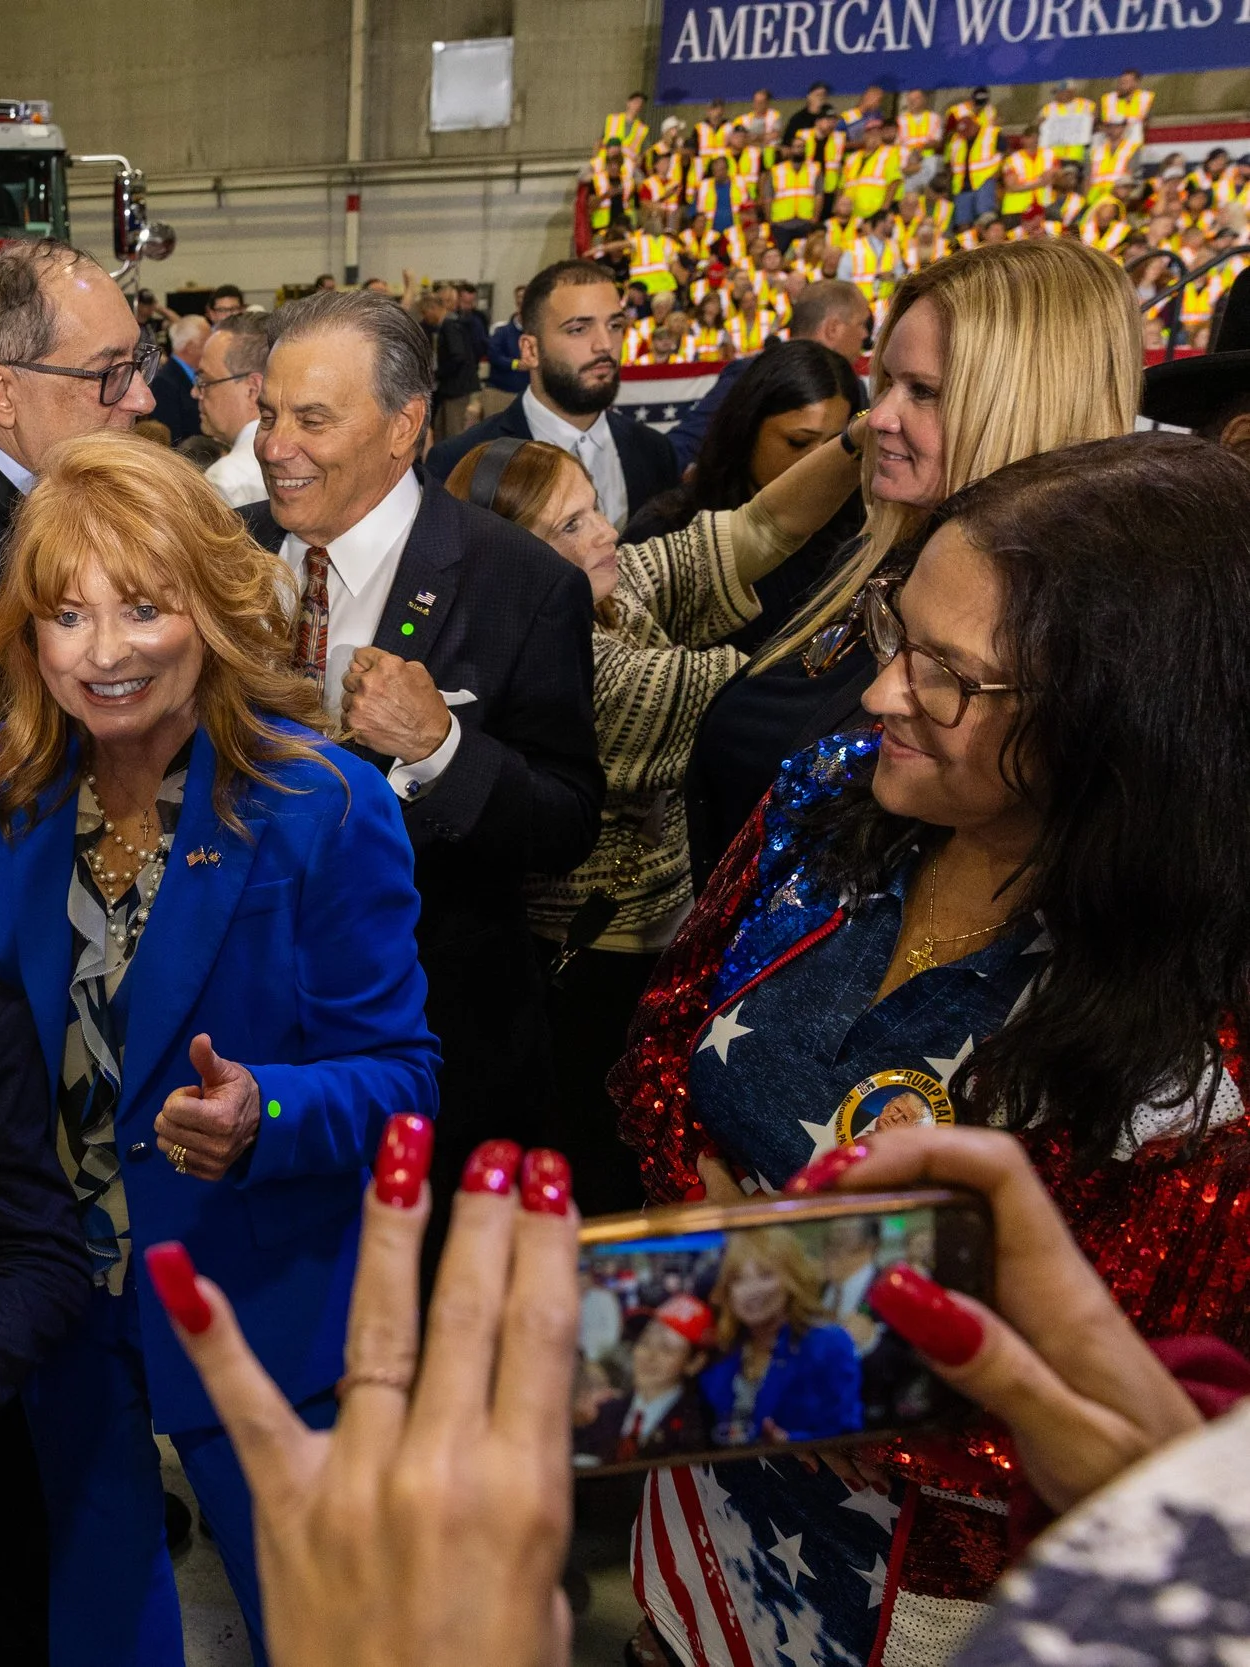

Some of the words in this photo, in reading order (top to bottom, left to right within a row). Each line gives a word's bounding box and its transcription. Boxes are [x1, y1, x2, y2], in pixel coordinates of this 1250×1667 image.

[670, 0, 939, 64] AMERICAN
[894, 1070, 941, 1099] TRUMP
[836, 1094, 854, 1136] Macungie,
